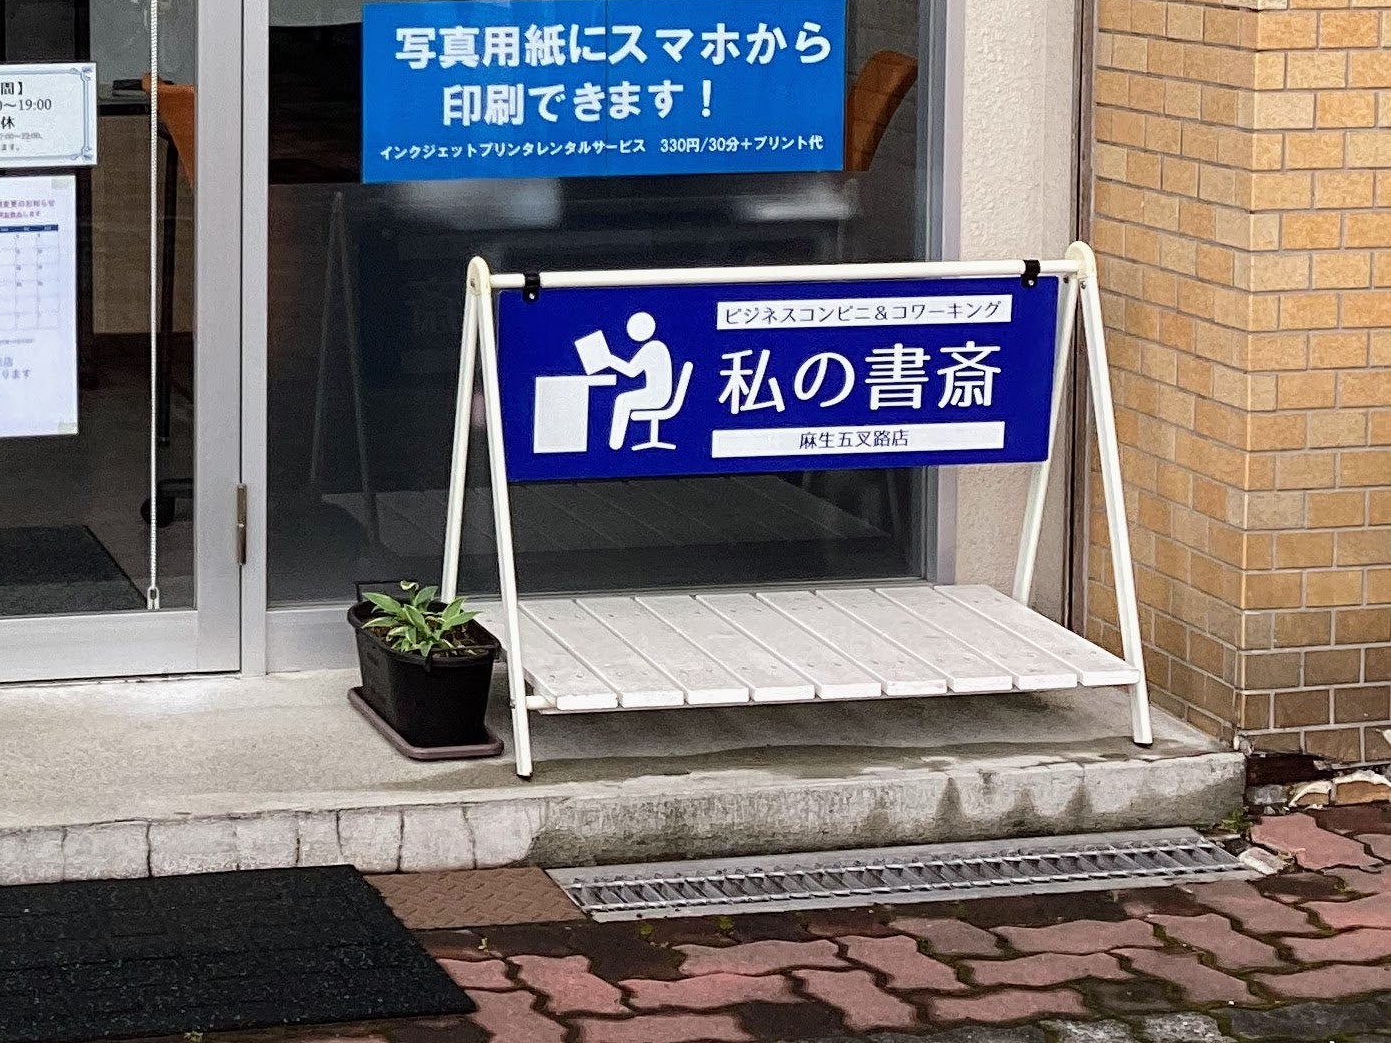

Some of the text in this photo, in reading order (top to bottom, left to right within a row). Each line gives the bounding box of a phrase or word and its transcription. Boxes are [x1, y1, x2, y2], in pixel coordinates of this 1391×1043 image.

[394, 20, 833, 69] 写真用紙にスマホから
[442, 79, 714, 127] 印刷できます！
[379, 138, 647, 161] インクジェットプリンタレンタルサービス
[725, 300, 1002, 326] ビジネスコンビニ&コワーキング
[717, 340, 1002, 415] 私の書斎
[799, 428, 910, 450] 麻生五叉路店
